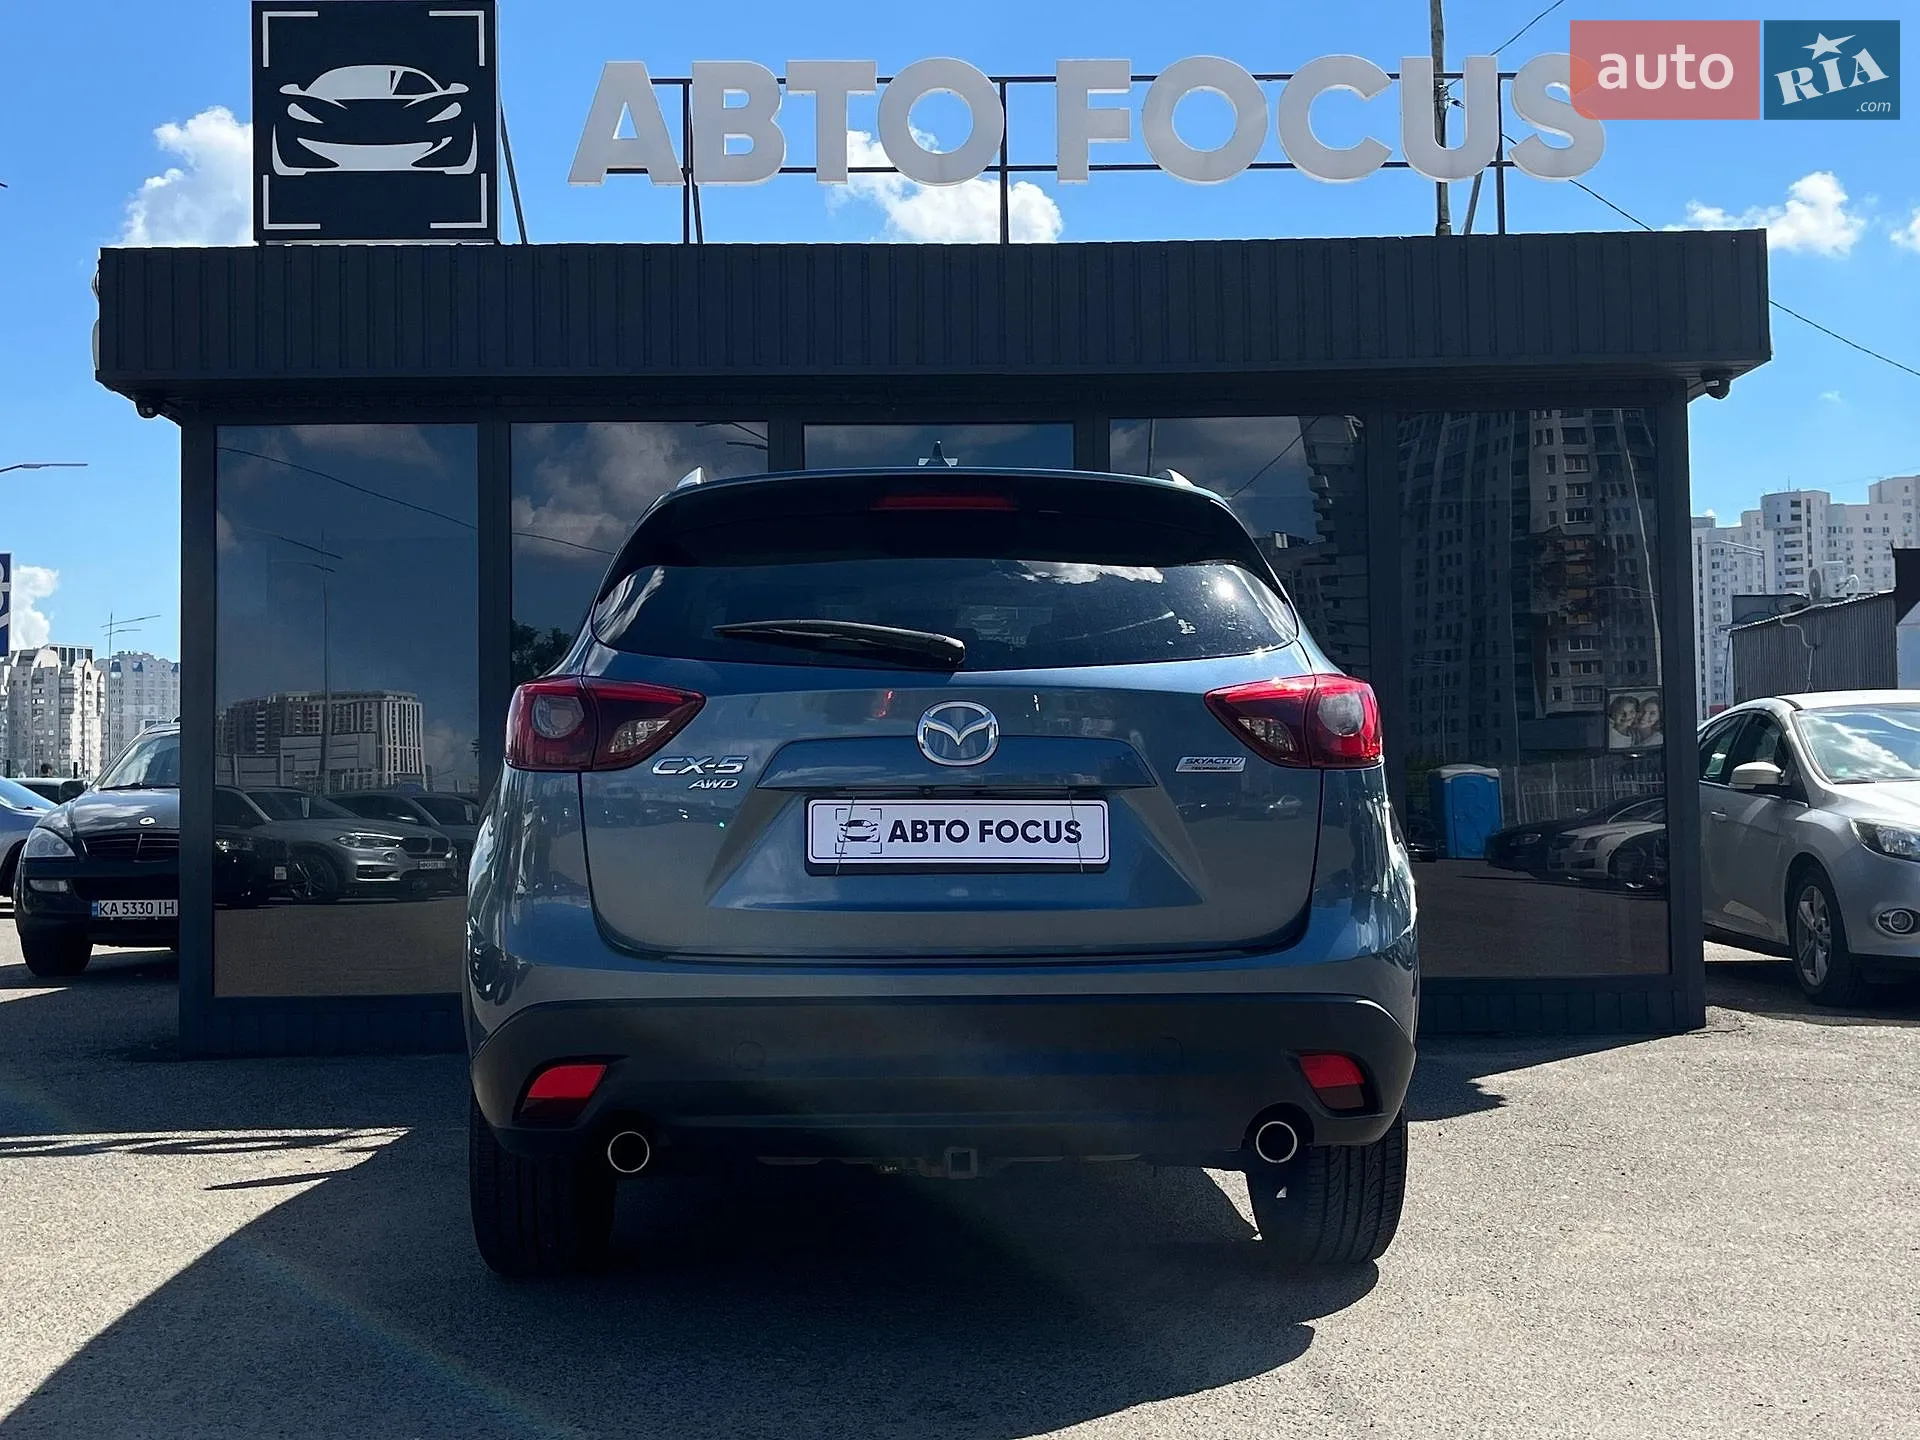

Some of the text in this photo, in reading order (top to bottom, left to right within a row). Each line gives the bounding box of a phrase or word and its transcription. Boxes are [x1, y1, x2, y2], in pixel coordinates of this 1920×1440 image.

[567, 53, 1606, 187] АВТО FOCUS
[652, 755, 749, 775] CX-5
[1184, 757, 1242, 765] SKYACTIV
[688, 778, 739, 790] AWD
[887, 819, 1082, 844] АВТО FOCUS
[99, 901, 175, 915] KA 5330 IH
